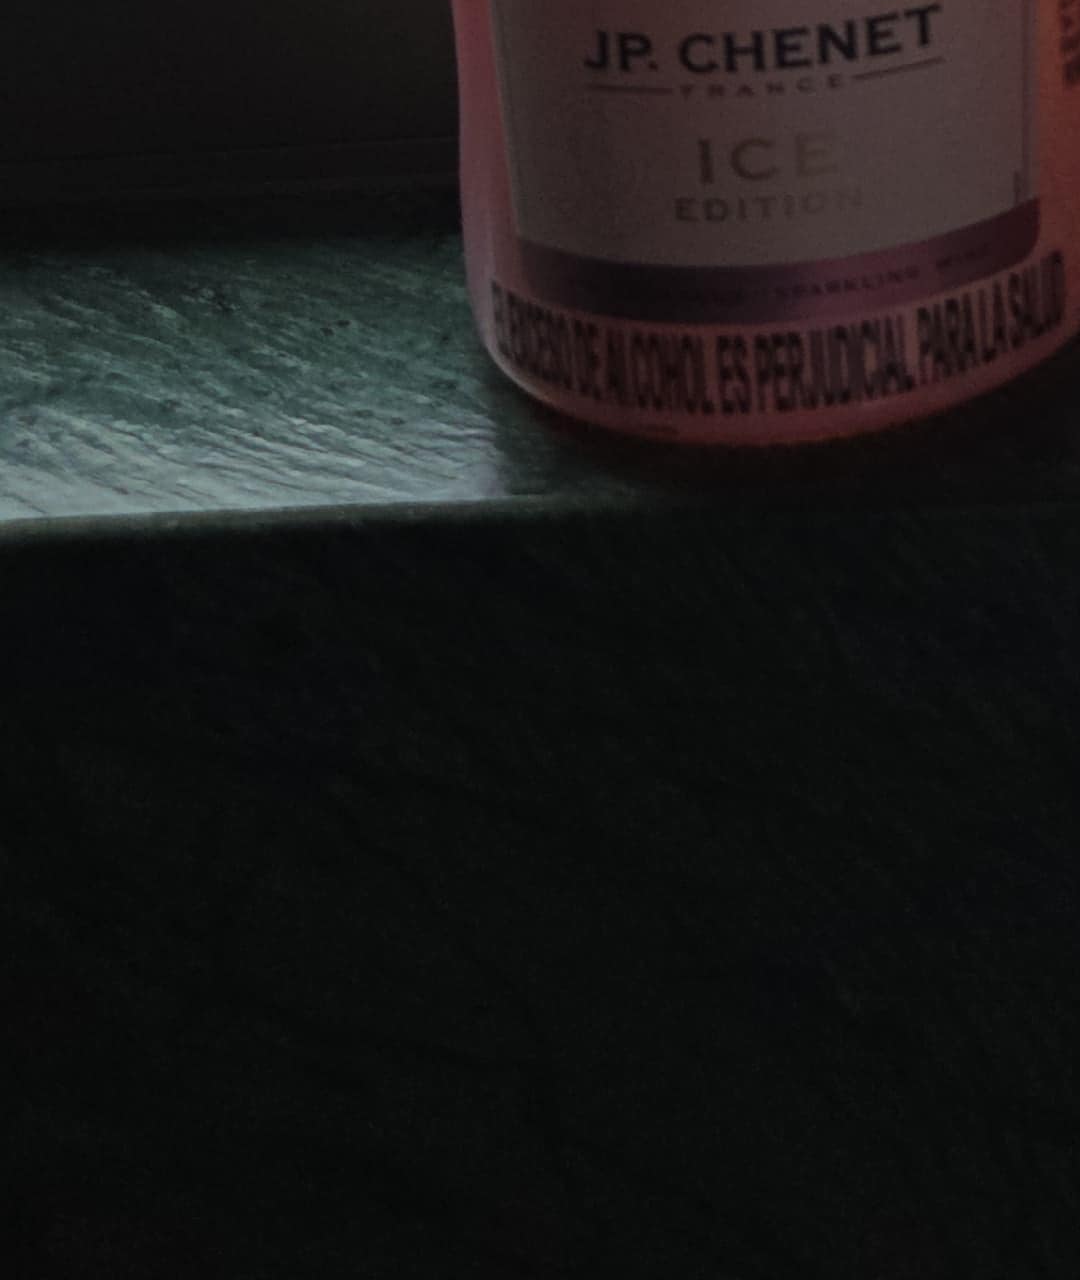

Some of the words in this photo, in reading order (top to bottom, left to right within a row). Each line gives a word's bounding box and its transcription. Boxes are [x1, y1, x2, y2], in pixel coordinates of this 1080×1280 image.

[584, 29, 660, 73] JP.
[676, 2, 943, 74] CHENET
[680, 73, 847, 100] FRANCE
[696, 132, 840, 185] ICE
[673, 186, 863, 223] EDITION
[607, 328, 715, 414] ALCOHOL
[717, 334, 750, 415] ES
[754, 314, 915, 412] PERJUDICIAL
[916, 299, 979, 385] PARA
